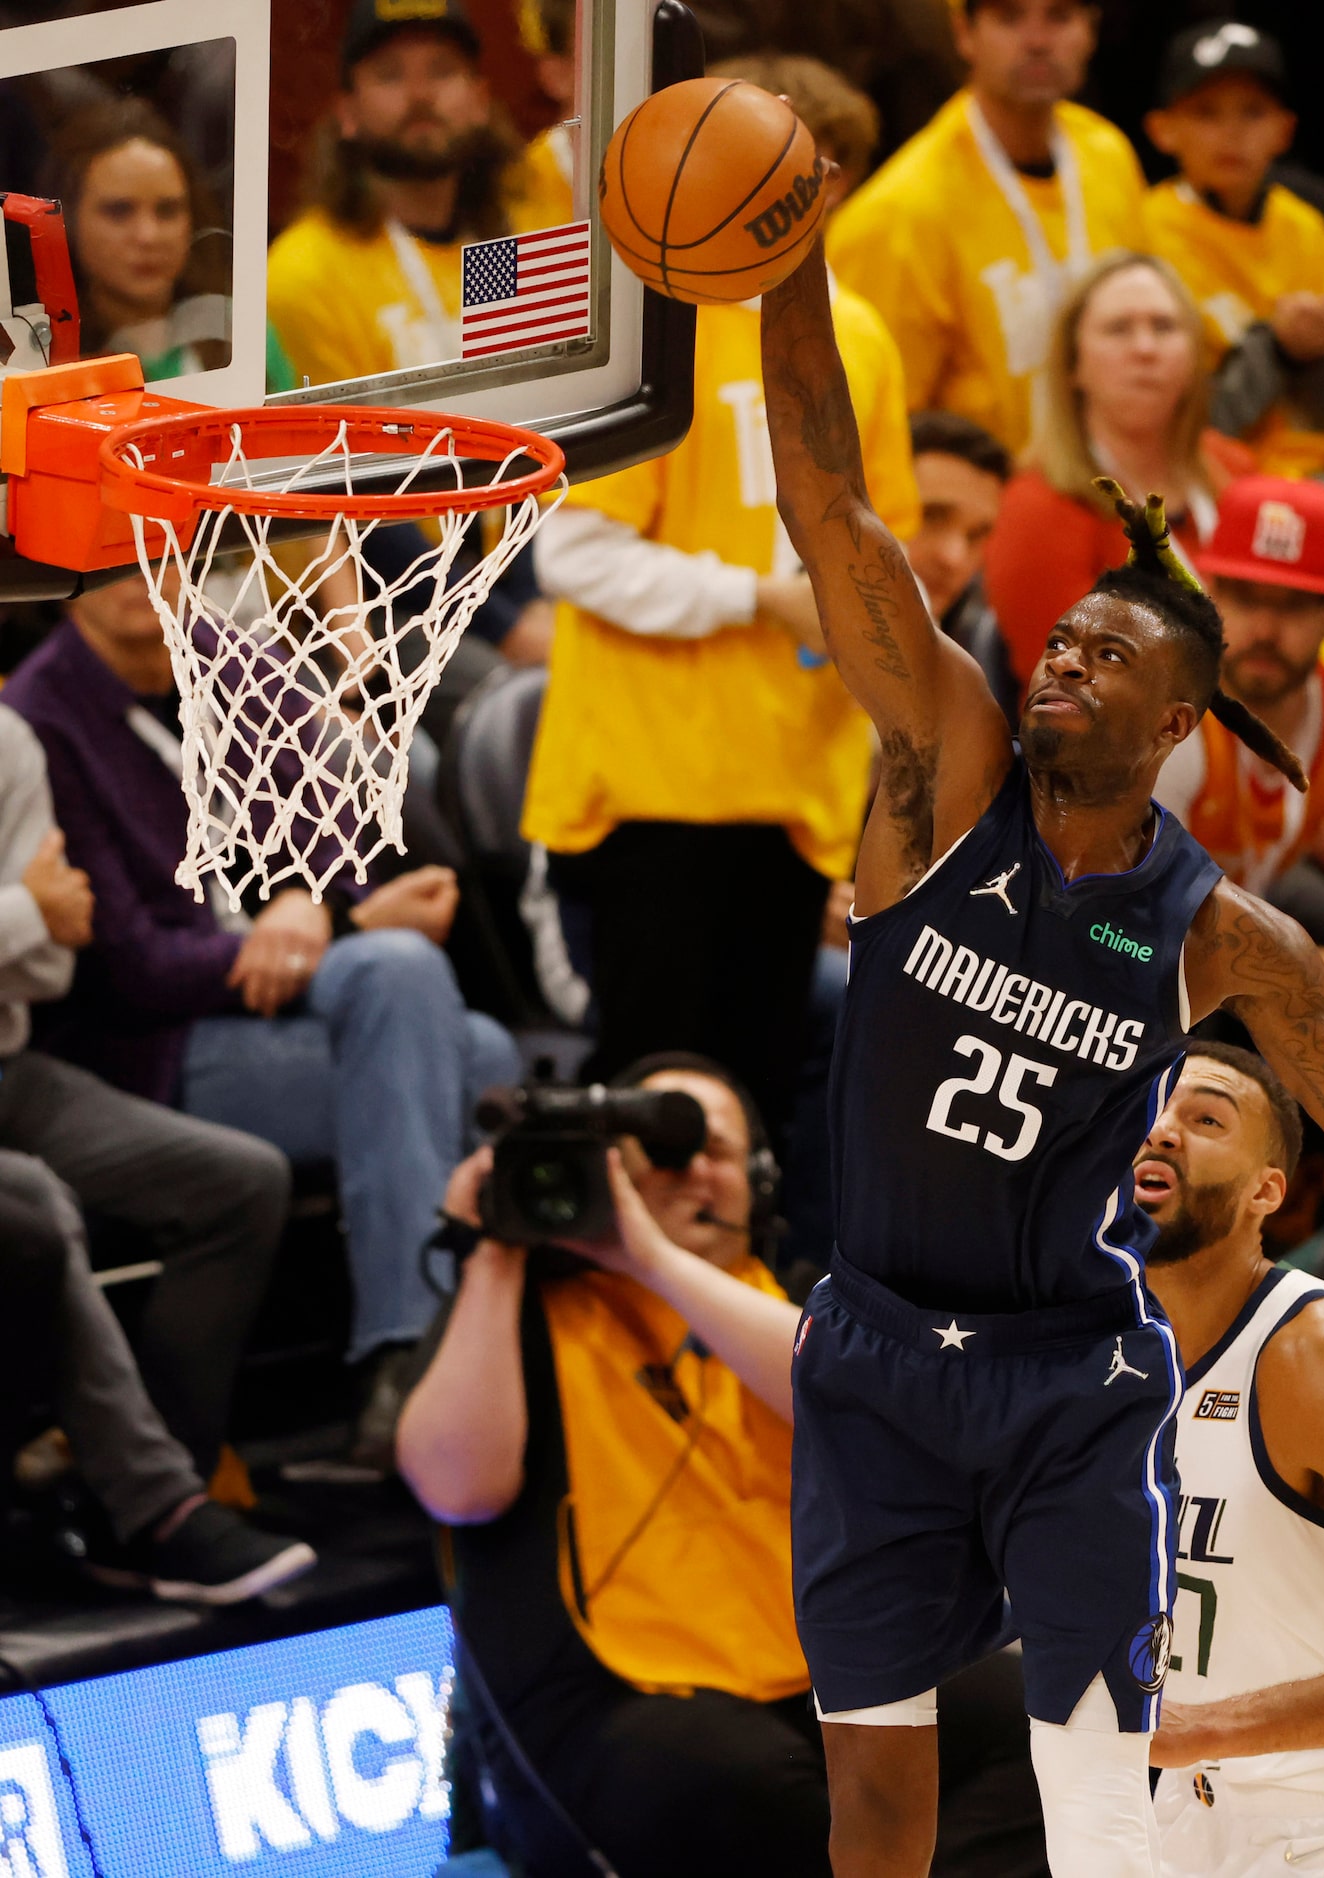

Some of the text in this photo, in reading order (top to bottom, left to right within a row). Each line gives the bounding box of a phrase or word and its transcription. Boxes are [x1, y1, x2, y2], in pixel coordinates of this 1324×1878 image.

[743, 157, 823, 248] Wilso
[1089, 922, 1153, 962] chime
[902, 924, 1145, 1071] MAVERICKS
[926, 1034, 1058, 1162] 25
[1198, 1393, 1217, 1417] 5
[1212, 1406, 1239, 1418] FIGHT
[1171, 1572, 1217, 1677] 7
